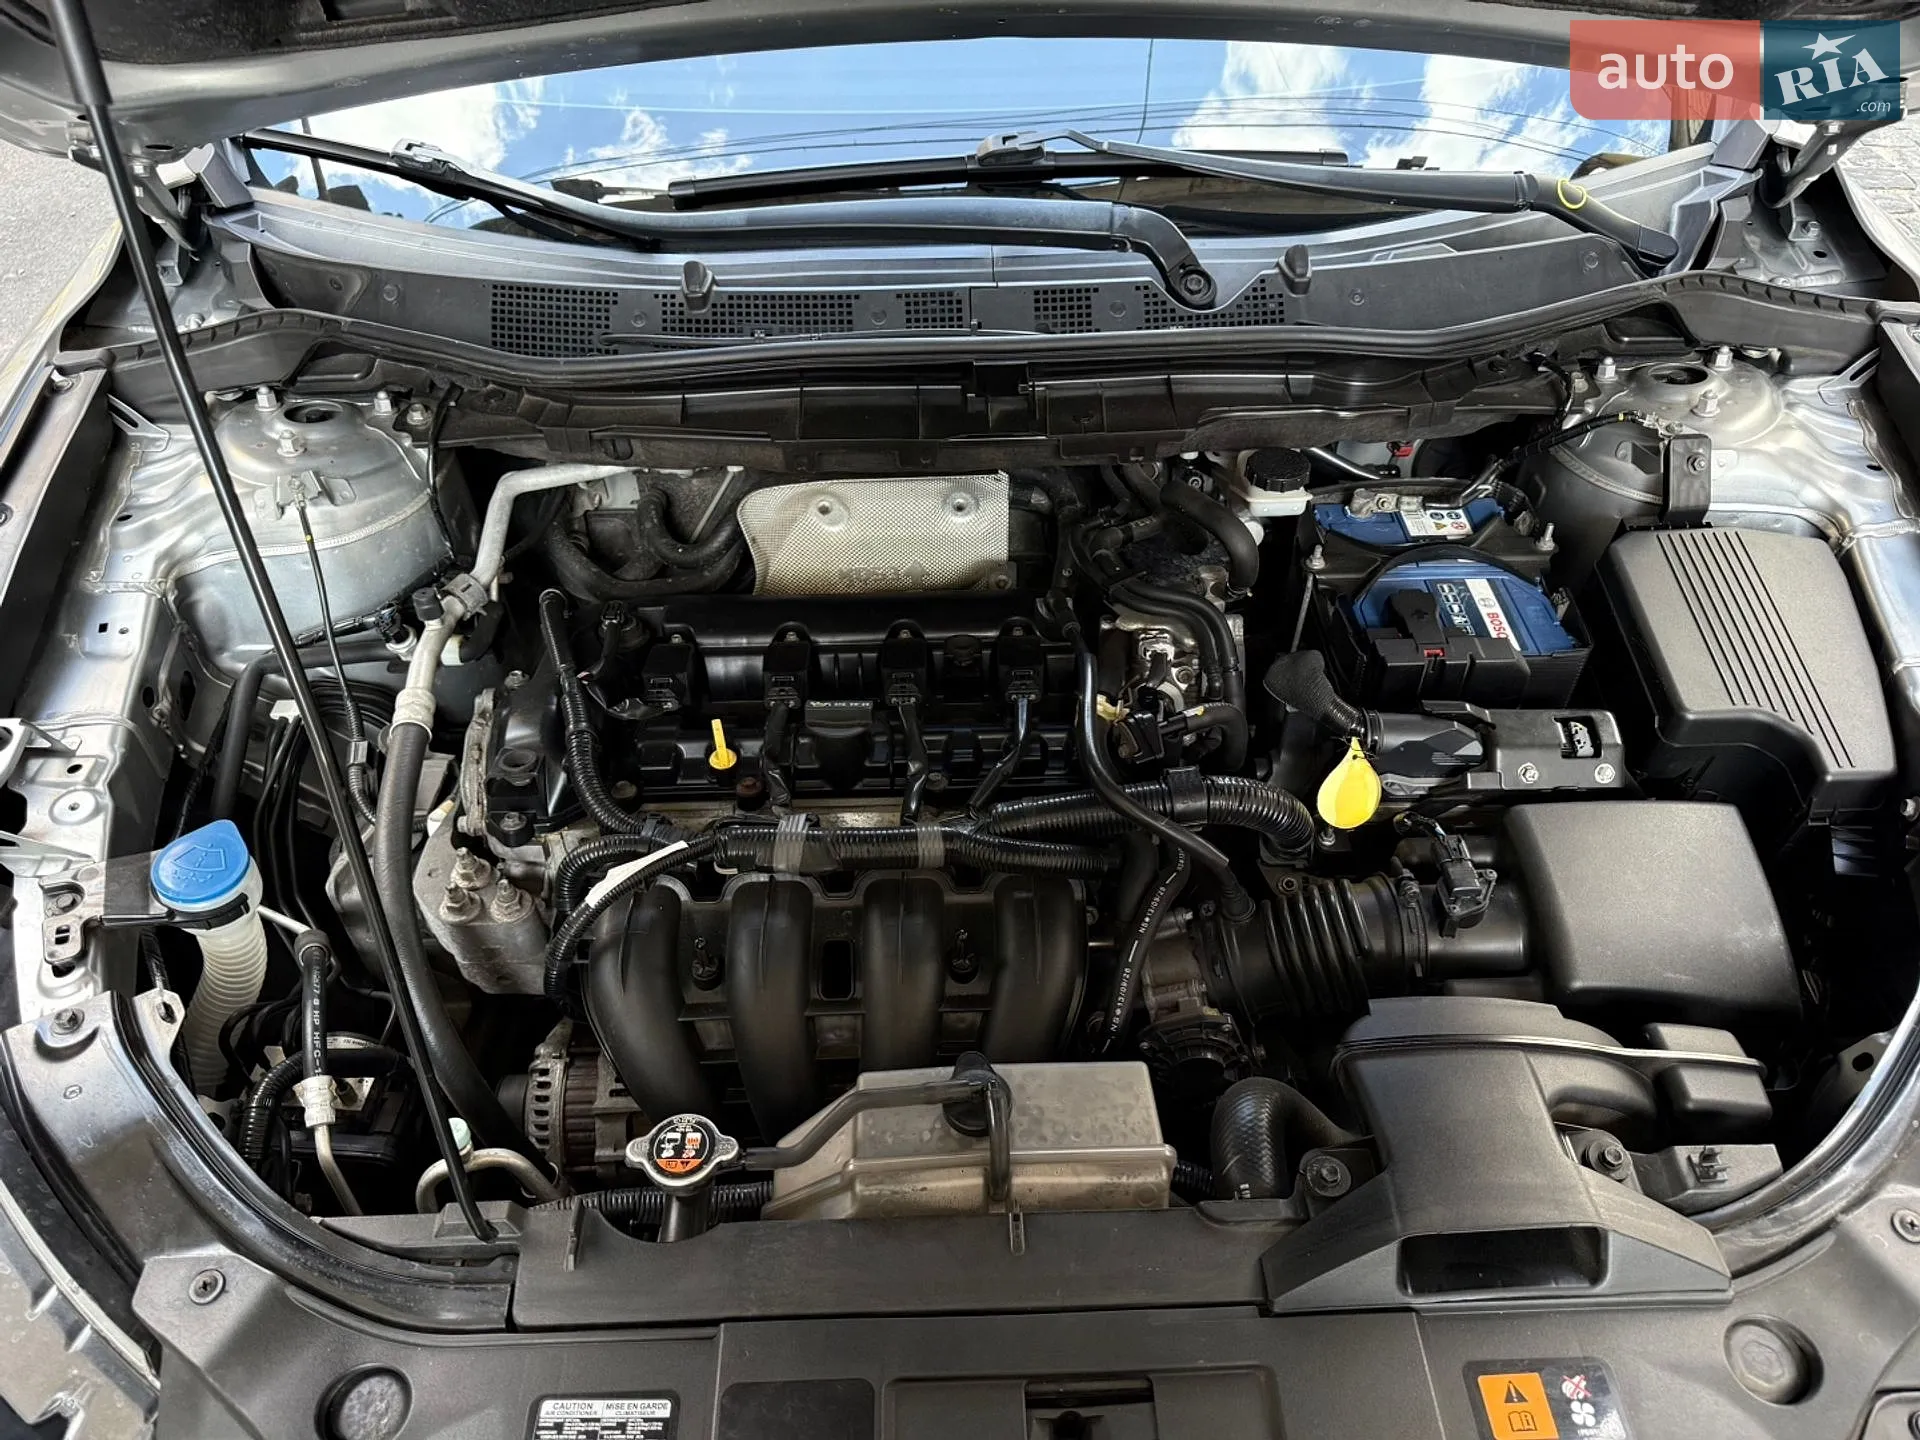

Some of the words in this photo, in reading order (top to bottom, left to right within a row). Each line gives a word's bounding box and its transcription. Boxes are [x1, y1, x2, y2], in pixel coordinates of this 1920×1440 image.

[1487, 612, 1509, 640] BOSC
[313, 1032, 321, 1077] HFC-1
[553, 1402, 593, 1410] CAUTION
[627, 1402, 638, 1410] EN
[640, 1402, 669, 1410] GARDE
